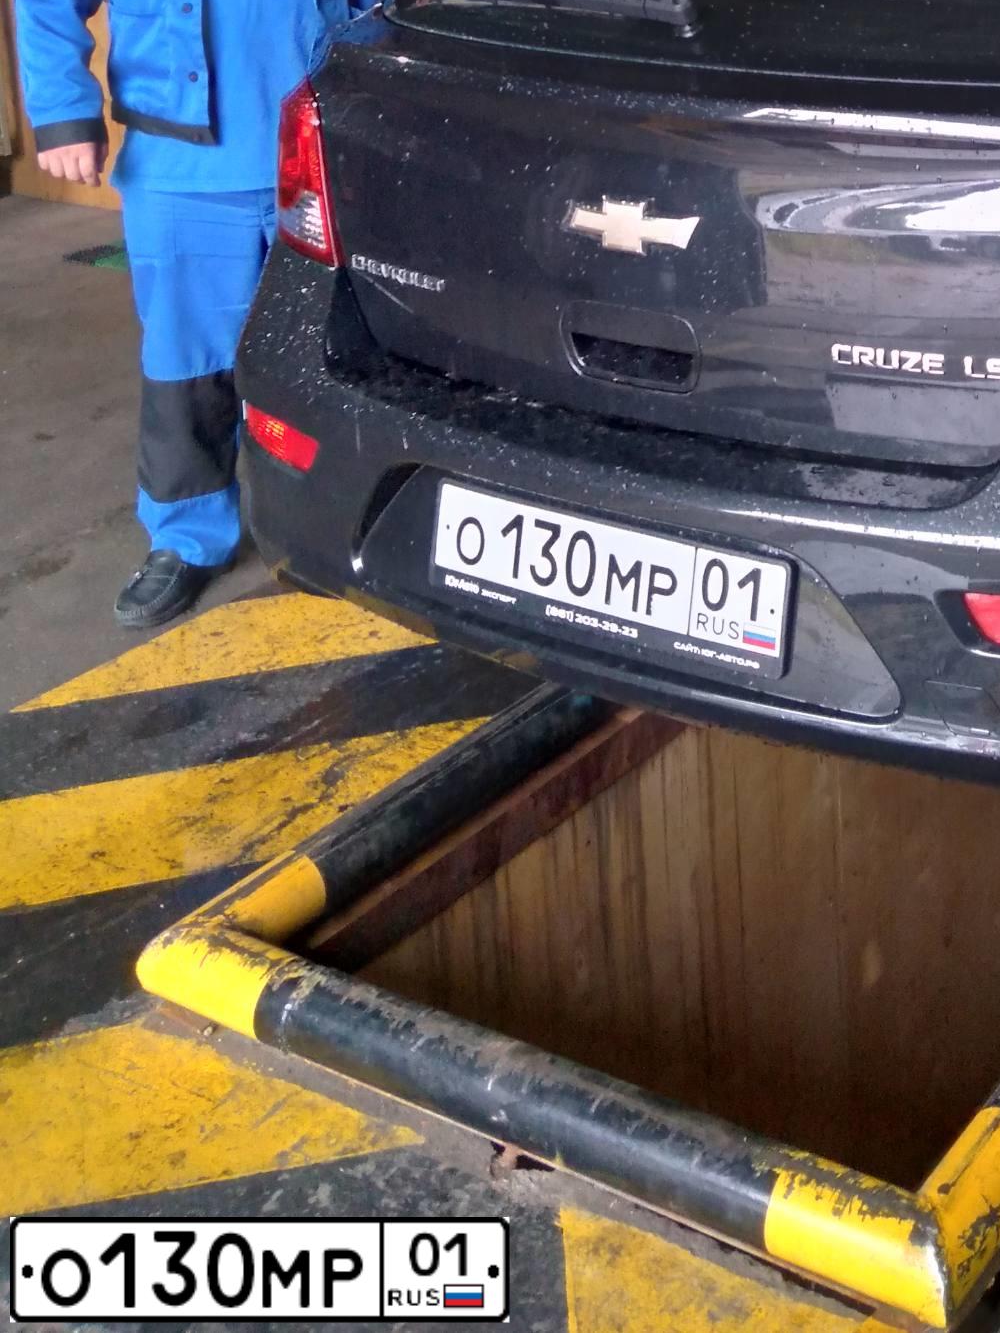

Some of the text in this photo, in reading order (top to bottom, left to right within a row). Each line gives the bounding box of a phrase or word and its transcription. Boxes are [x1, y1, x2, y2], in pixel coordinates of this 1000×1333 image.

[831, 343, 945, 375] CRUZE
[701, 558, 762, 622] 01
[696, 612, 740, 641] RUS
